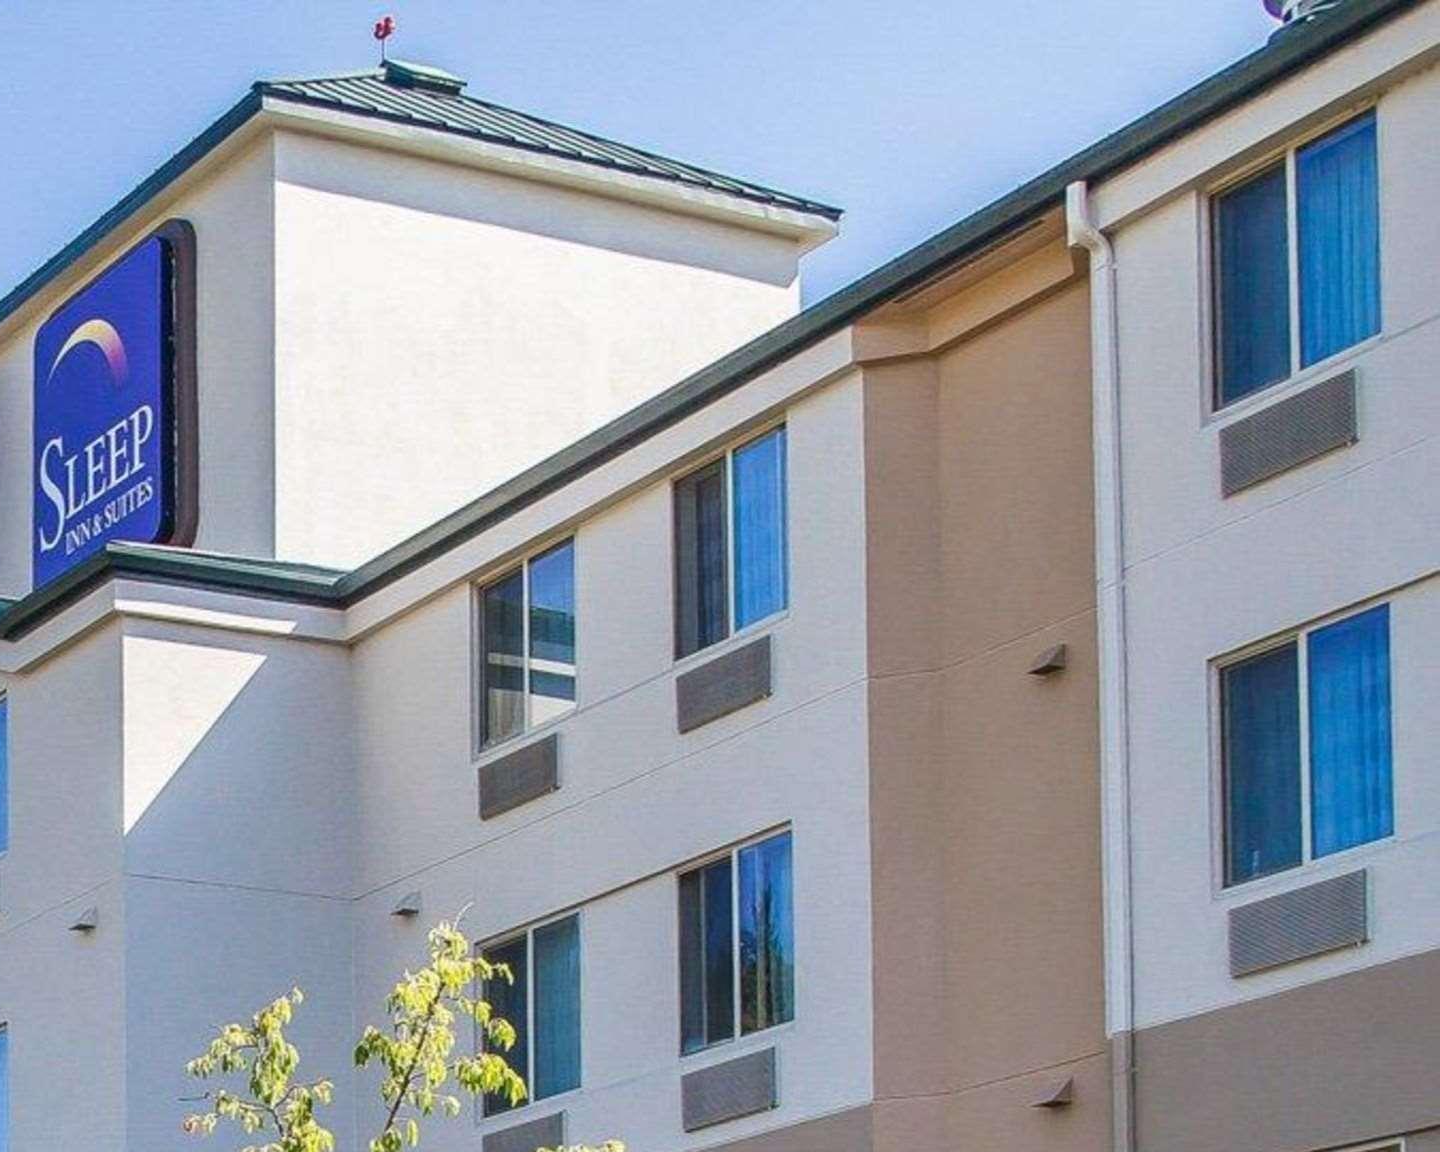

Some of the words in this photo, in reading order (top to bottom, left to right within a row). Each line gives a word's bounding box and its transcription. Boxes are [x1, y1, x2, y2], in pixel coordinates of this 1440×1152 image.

[39, 404, 153, 553] SLEEP
[65, 518, 91, 556] INN
[92, 513, 103, 537] &
[103, 481, 153, 528] SUITES
